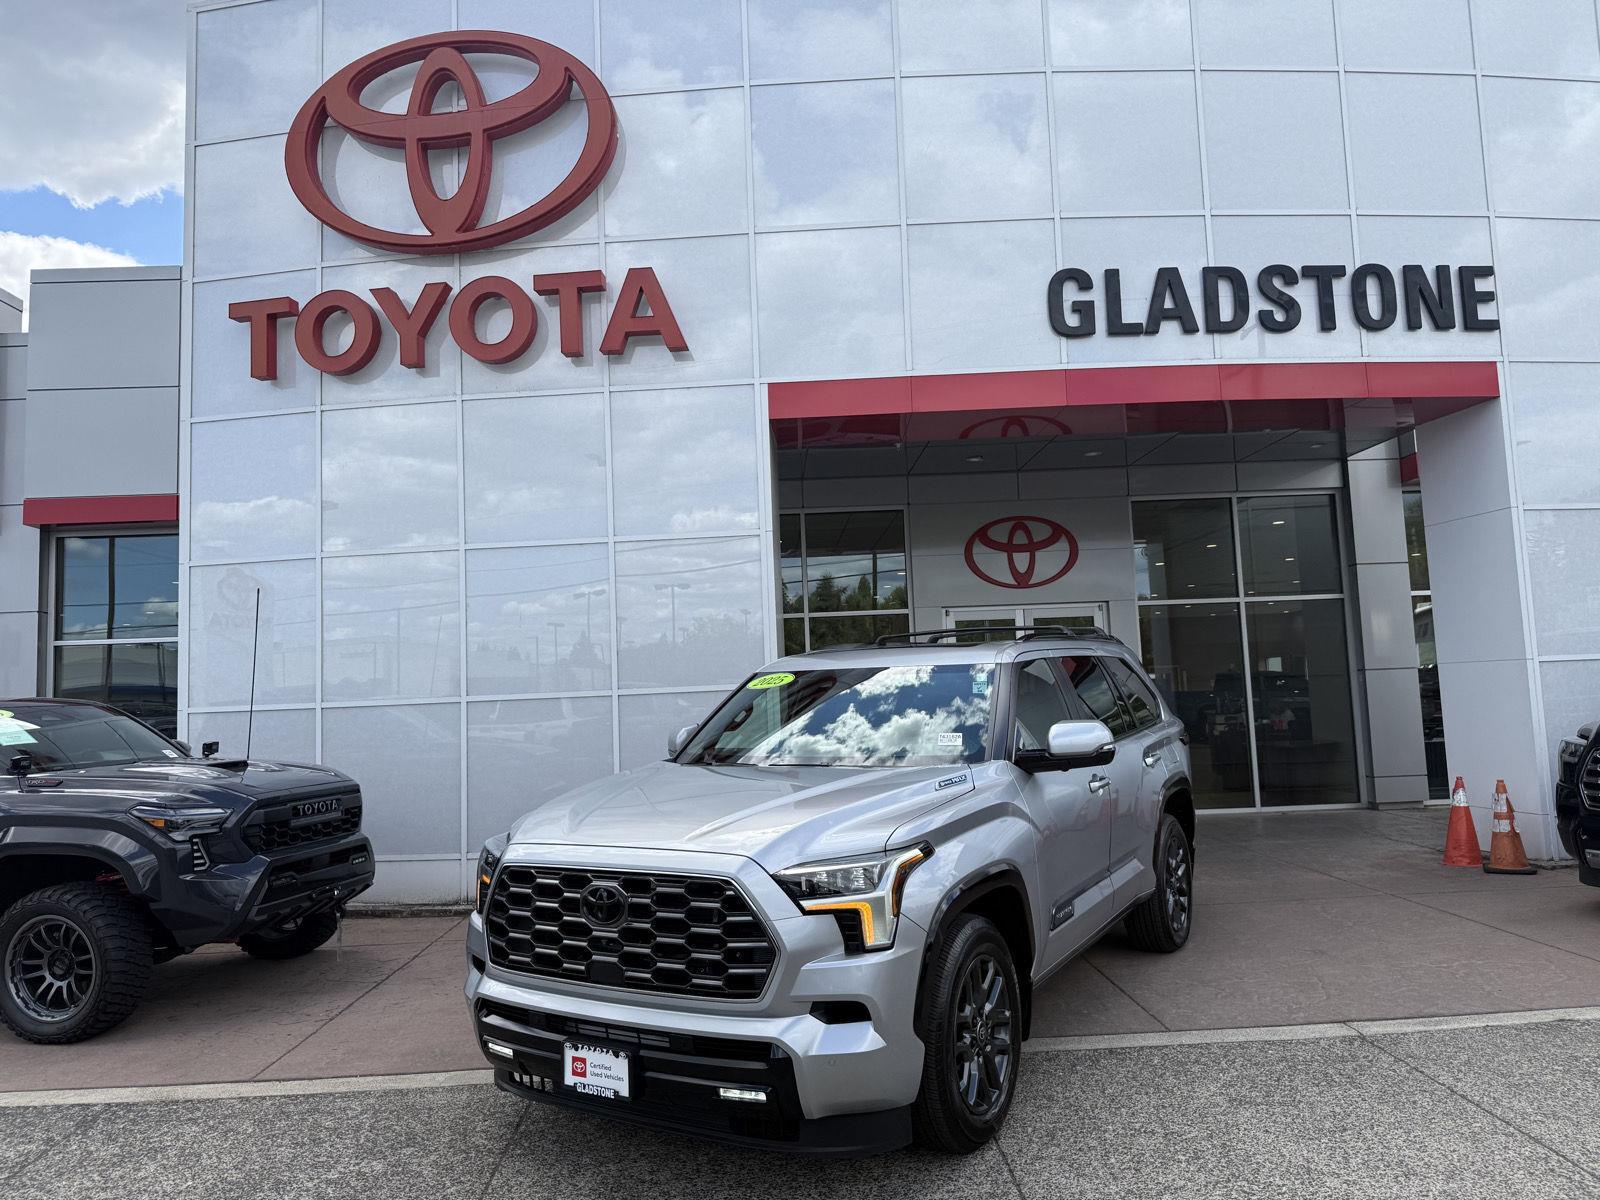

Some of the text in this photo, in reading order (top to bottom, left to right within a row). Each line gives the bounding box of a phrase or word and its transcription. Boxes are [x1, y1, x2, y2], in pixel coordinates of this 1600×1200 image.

[1048, 263, 1500, 337] GLADSTONE
[229, 267, 689, 381] TOYOTA
[751, 675, 788, 686] 2025
[297, 800, 338, 816] TOYOTA
[577, 1044, 614, 1056] TOYOTA
[589, 1062, 611, 1071] Certified
[589, 1071, 624, 1082] Used Vehicles
[577, 1083, 615, 1098] GLADSTONE
